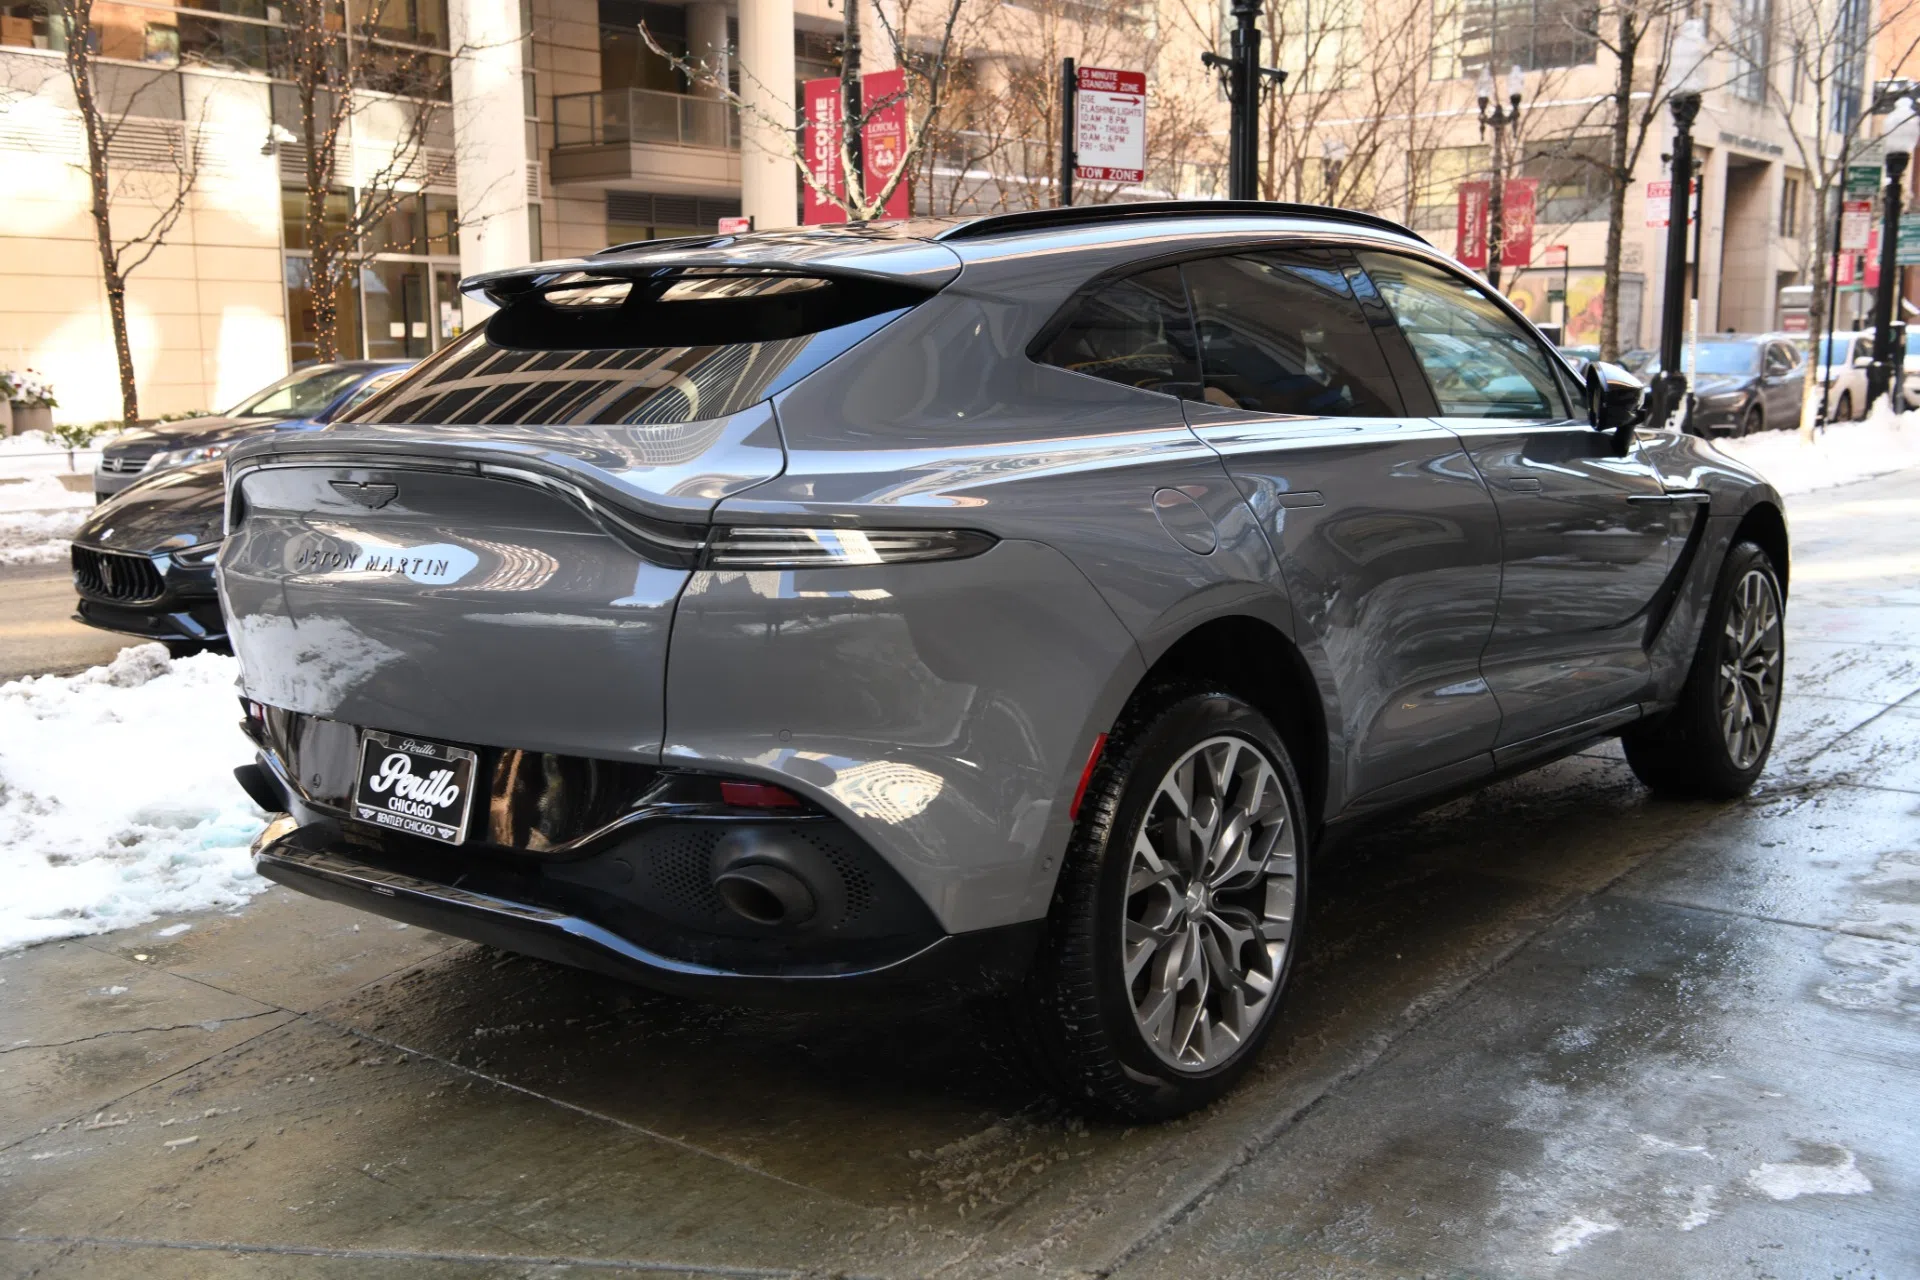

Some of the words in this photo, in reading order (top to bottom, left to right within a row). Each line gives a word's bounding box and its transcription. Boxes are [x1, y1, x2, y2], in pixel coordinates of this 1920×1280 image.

[1081, 70, 1088, 78] 15
[1091, 71, 1118, 81] MINUTE
[1081, 80, 1117, 90] STANDING
[1120, 83, 1139, 93] ZONE
[1081, 95, 1096, 103] USE
[1080, 104, 1116, 115] FLASHING
[1117, 108, 1142, 117] LIGHTS
[1090, 114, 1101, 122] AM
[1115, 116, 1127, 124] PM
[868, 122, 900, 133] LOYOLA
[1080, 123, 1096, 131] MON
[1105, 125, 1130, 134] THURS
[1080, 132, 1088, 140] 10
[1089, 133, 1100, 141] AM
[1114, 135, 1125, 143] PM
[816, 97, 828, 206] WELCOME
[1080, 142, 1092, 151] FRI
[1099, 143, 1115, 152] SUN
[1080, 167, 1103, 178] TOW
[1108, 169, 1138, 181] ZONE
[298, 548, 359, 569] ASTON
[365, 556, 450, 576] MARTIN
[399, 738, 436, 756] Perillo
[369, 753, 460, 808] Perillo
[388, 797, 433, 818] CHICAGO
[376, 812, 404, 829] BENTLEY
[404, 819, 436, 836] CHICAGO
